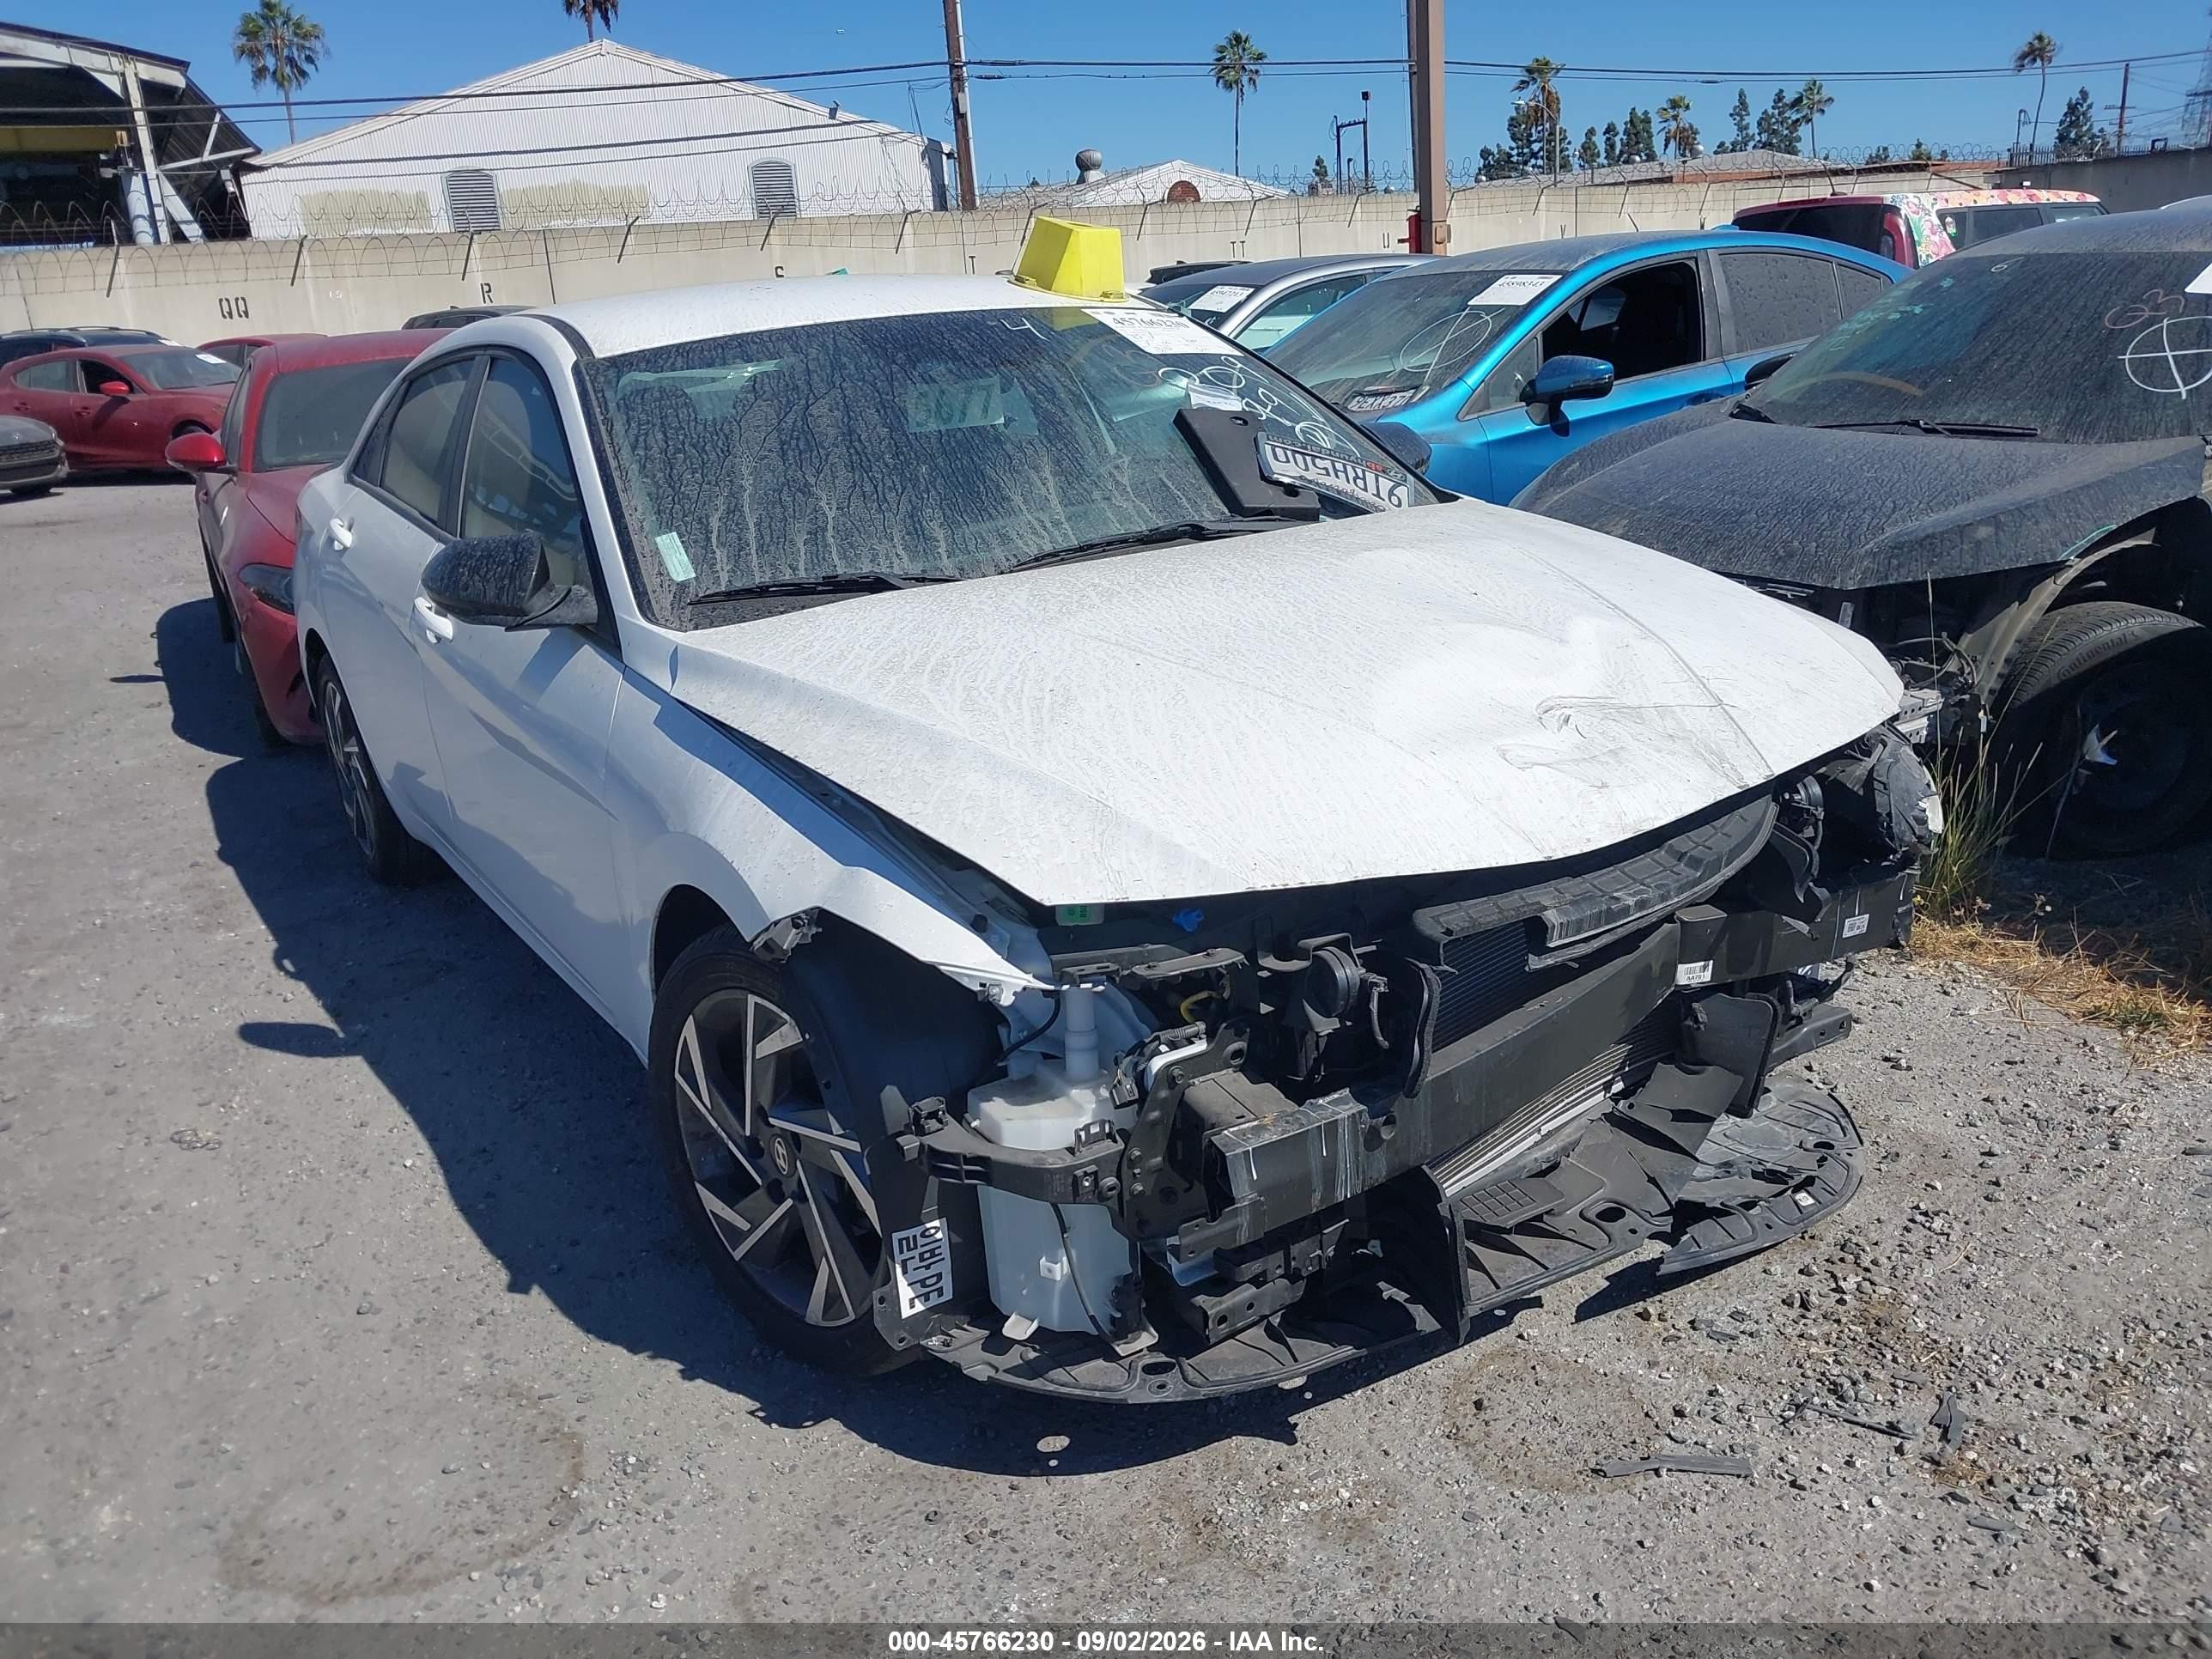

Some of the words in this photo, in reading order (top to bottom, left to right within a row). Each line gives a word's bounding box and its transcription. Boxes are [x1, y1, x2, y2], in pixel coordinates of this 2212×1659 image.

[1382, 232, 1389, 249] U
[480, 283, 494, 304] R
[218, 296, 250, 319] QQ
[1272, 446, 1404, 509] 9TRH500
